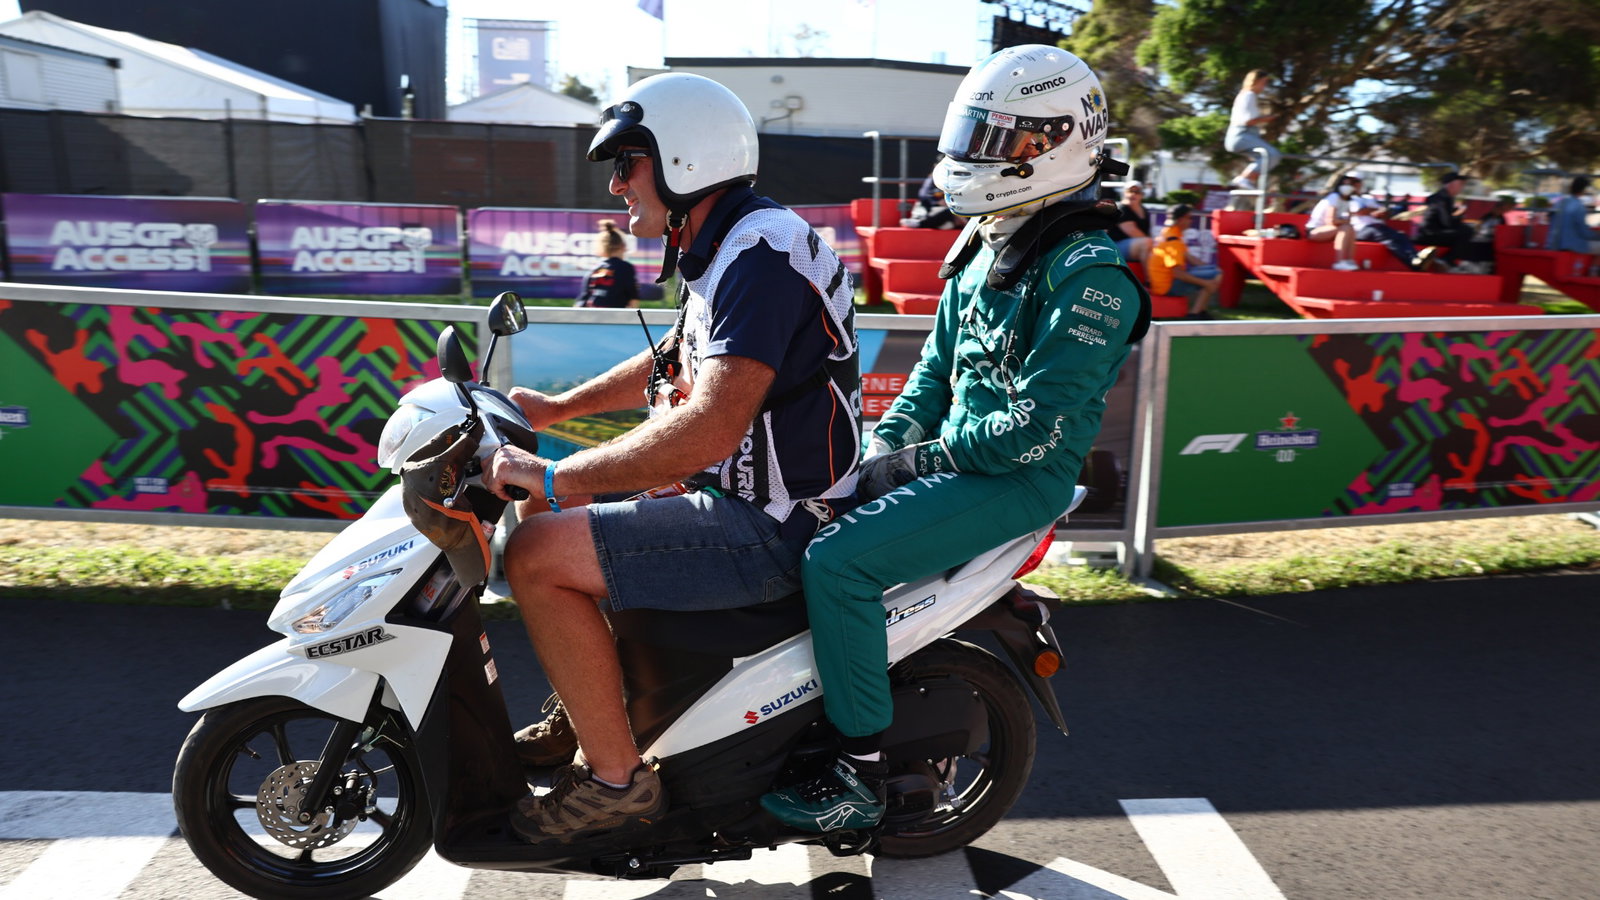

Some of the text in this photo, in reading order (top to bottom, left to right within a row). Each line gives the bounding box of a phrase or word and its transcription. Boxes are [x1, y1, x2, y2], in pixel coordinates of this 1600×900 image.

[1020, 76, 1066, 95] aramco
[995, 186, 1032, 199] crypto.com
[1082, 287, 1122, 311] EPOS
[1071, 304, 1103, 321] PIRELLI
[1067, 327, 1107, 346] PERREGAUX
[1078, 324, 1103, 336] GIRARD
[357, 540, 415, 572] SUZUKI
[307, 627, 391, 659] ECSTAR
[760, 679, 818, 716] SUZUKI
